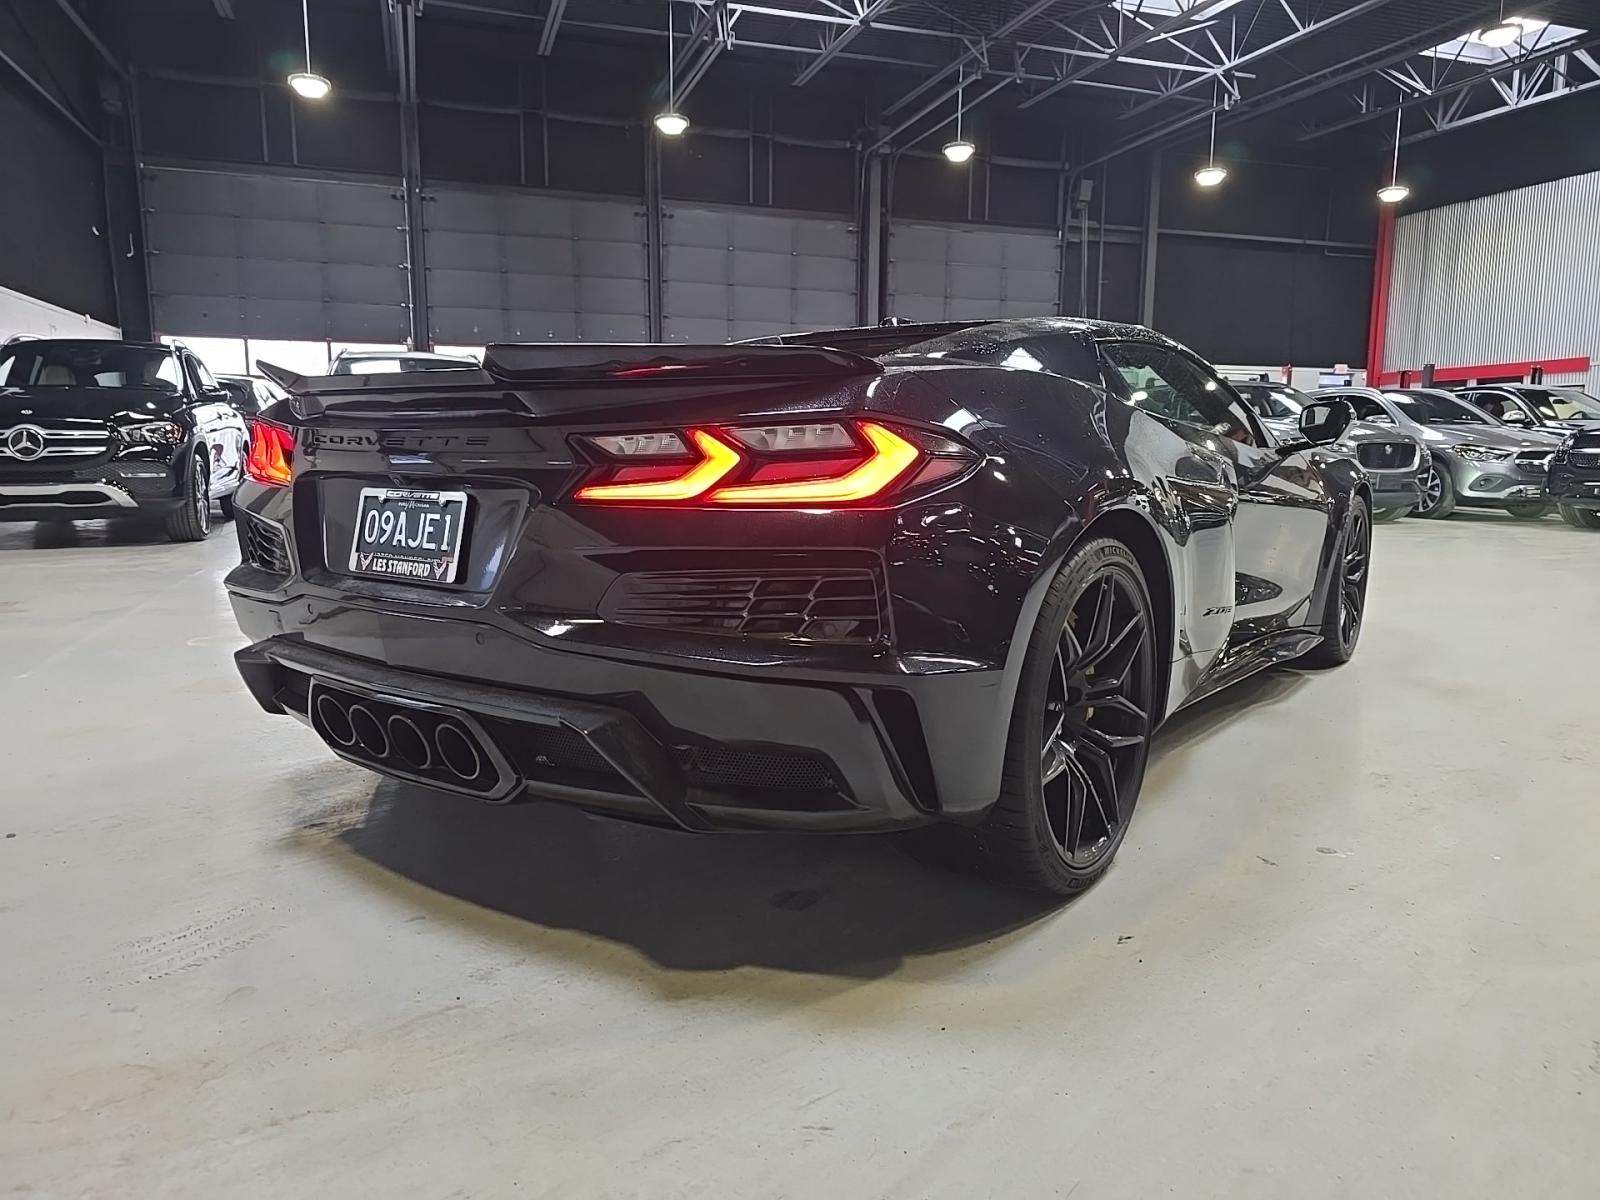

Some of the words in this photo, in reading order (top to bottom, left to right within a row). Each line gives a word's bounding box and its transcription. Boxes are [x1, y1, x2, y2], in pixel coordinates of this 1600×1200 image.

[314, 434, 489, 446] CORVETTE
[364, 509, 452, 551] 09AJE1
[372, 558, 387, 571] LES
[387, 560, 431, 577] STANFORD
